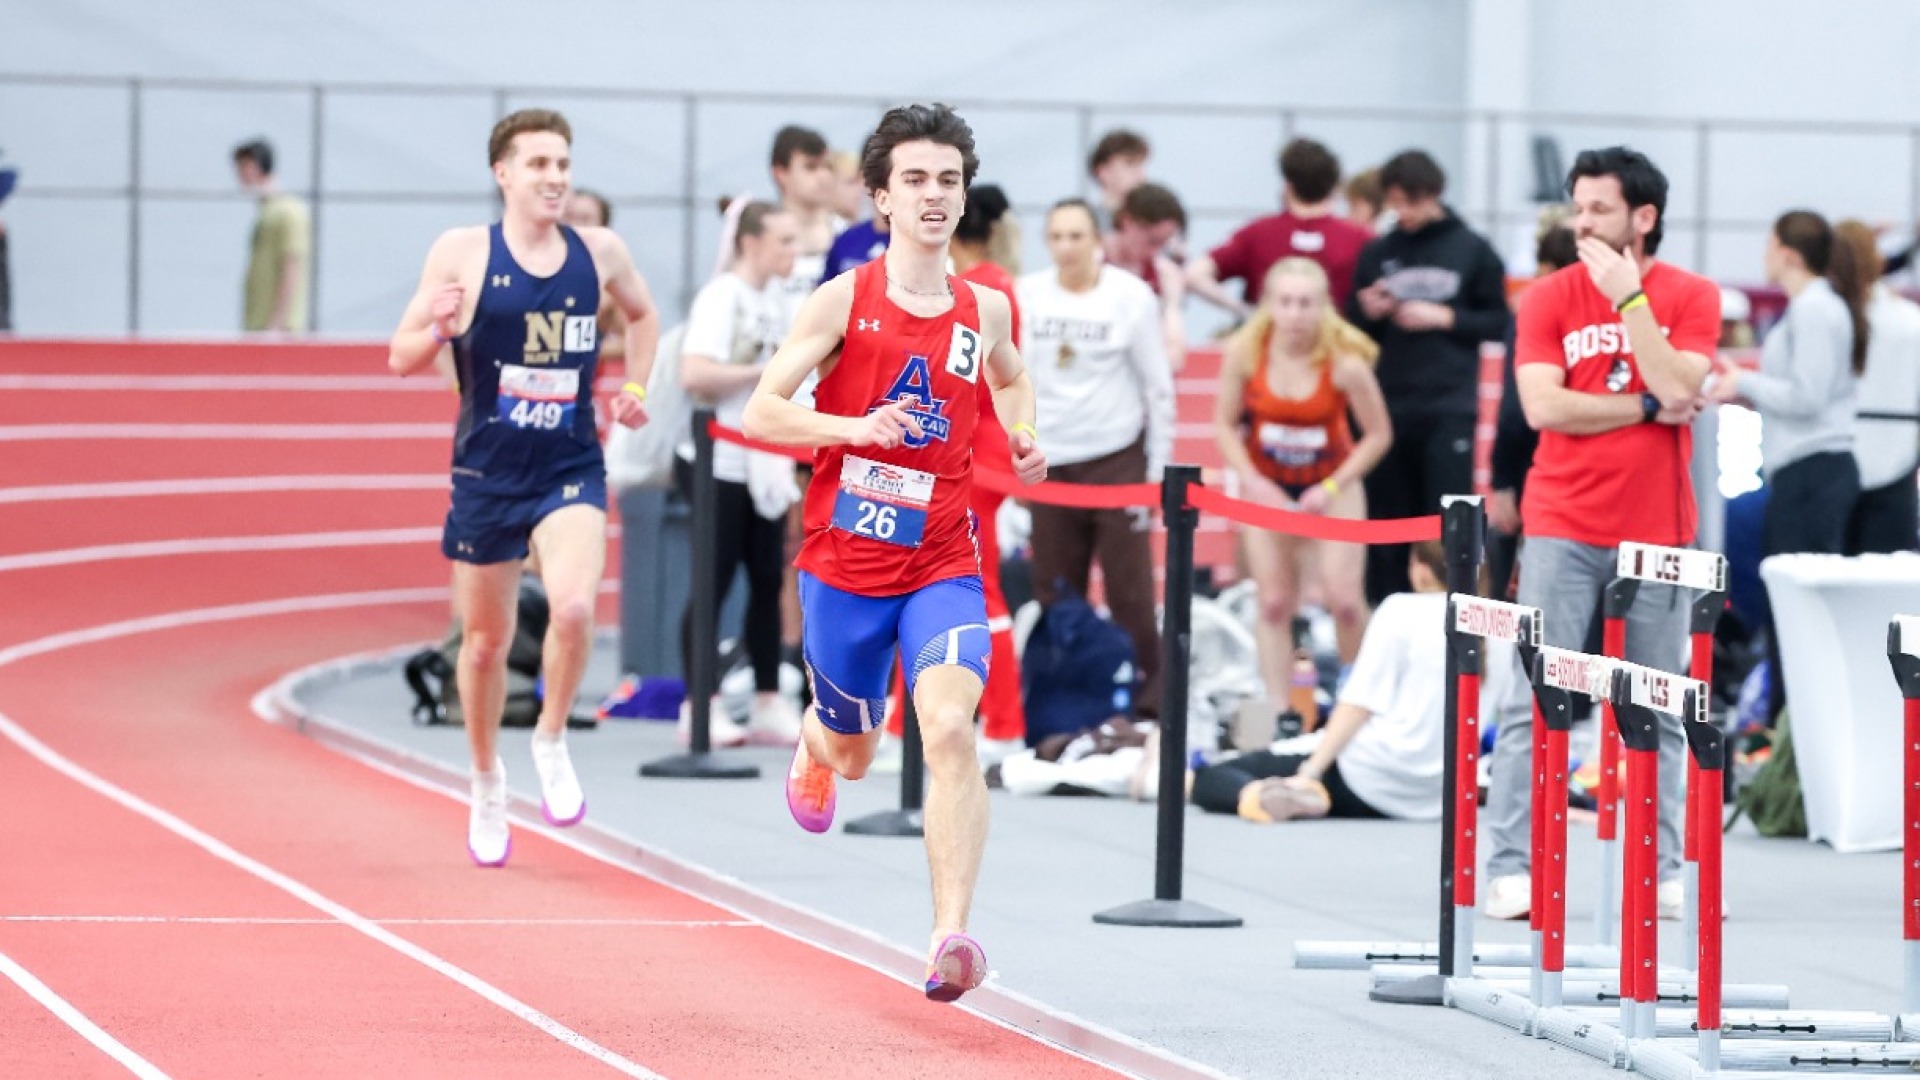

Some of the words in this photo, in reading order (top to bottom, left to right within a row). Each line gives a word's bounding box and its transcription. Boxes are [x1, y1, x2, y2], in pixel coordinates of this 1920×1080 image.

[523, 311, 565, 352] N
[1563, 323, 1670, 369] BOST
[954, 330, 976, 376] 3
[509, 399, 563, 431] 449
[855, 501, 897, 539] 26
[1655, 551, 1681, 582] UCS
[1651, 674, 1670, 707] UCS
